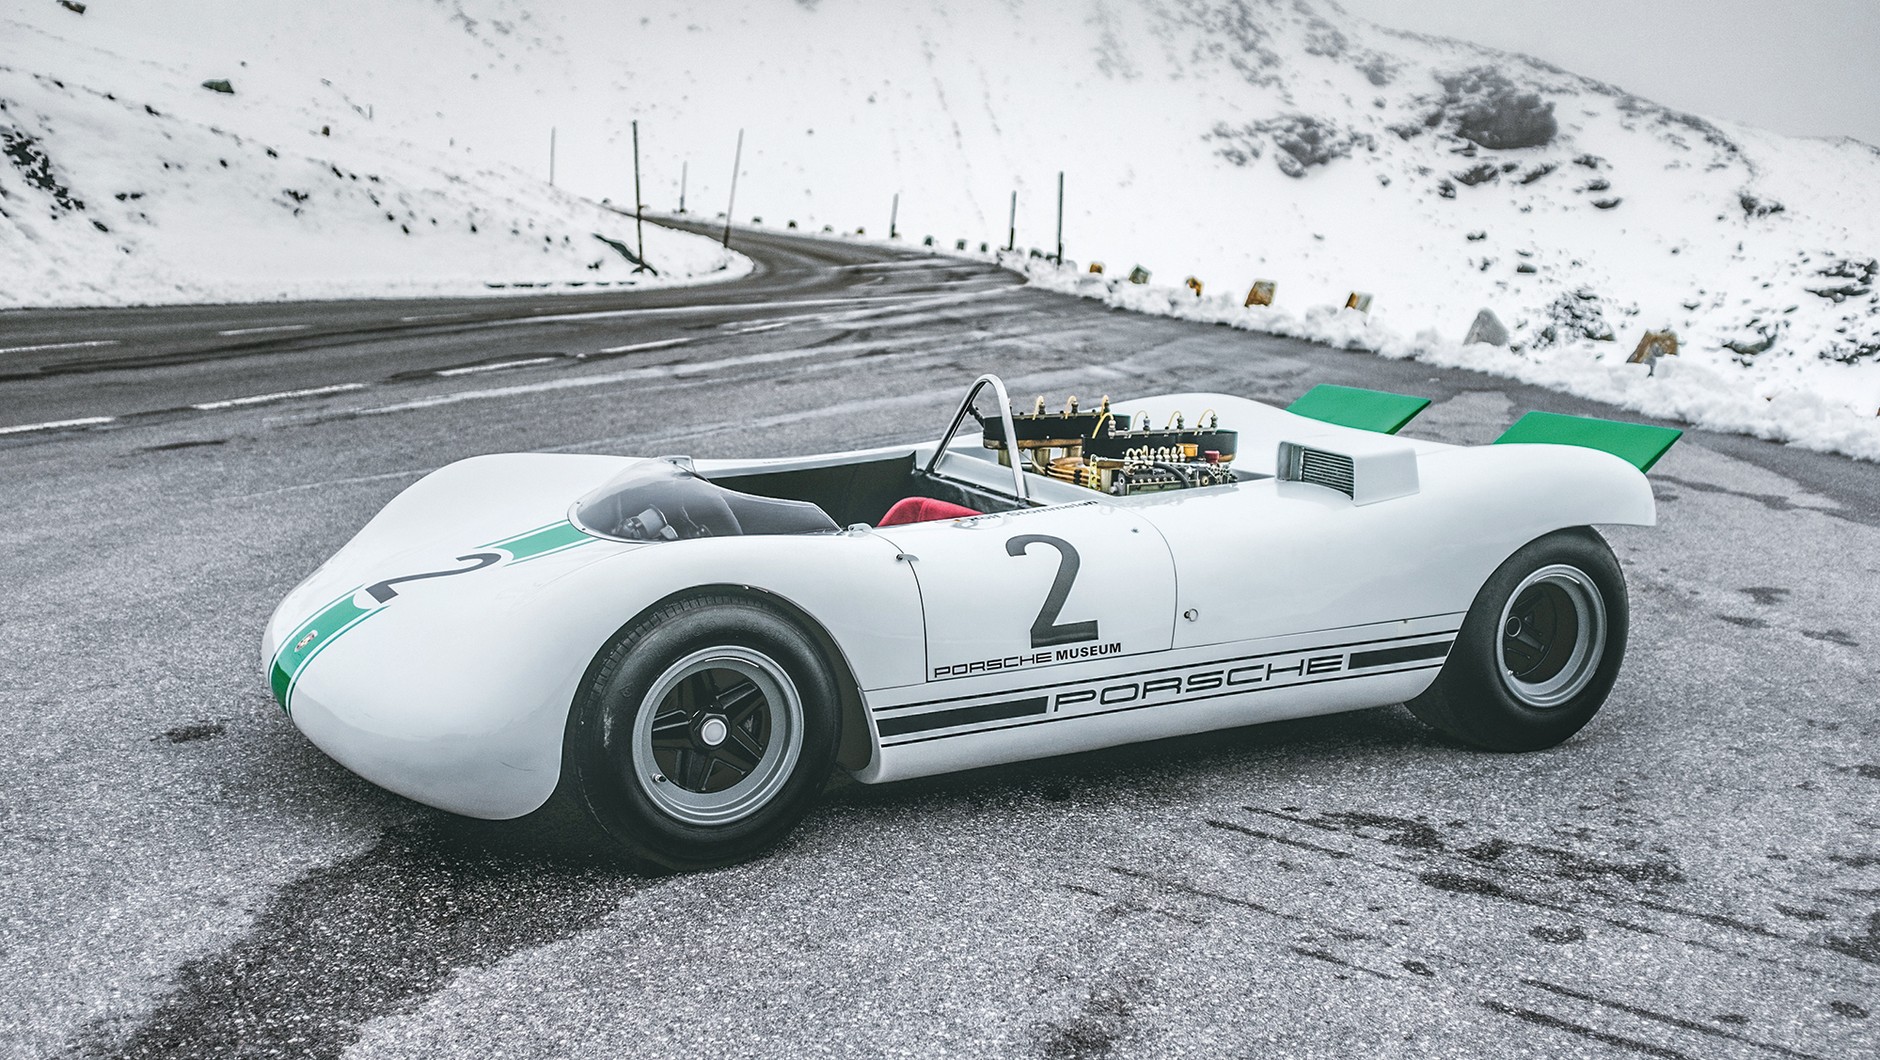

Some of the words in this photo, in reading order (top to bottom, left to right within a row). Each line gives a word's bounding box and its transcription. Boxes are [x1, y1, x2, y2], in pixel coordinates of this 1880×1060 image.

[366, 552, 502, 604] 2
[1005, 534, 1099, 649] 2
[934, 651, 1053, 679] PORSCHE
[1056, 643, 1121, 661] MUSEUM
[1053, 654, 1344, 713] PORSCHE
